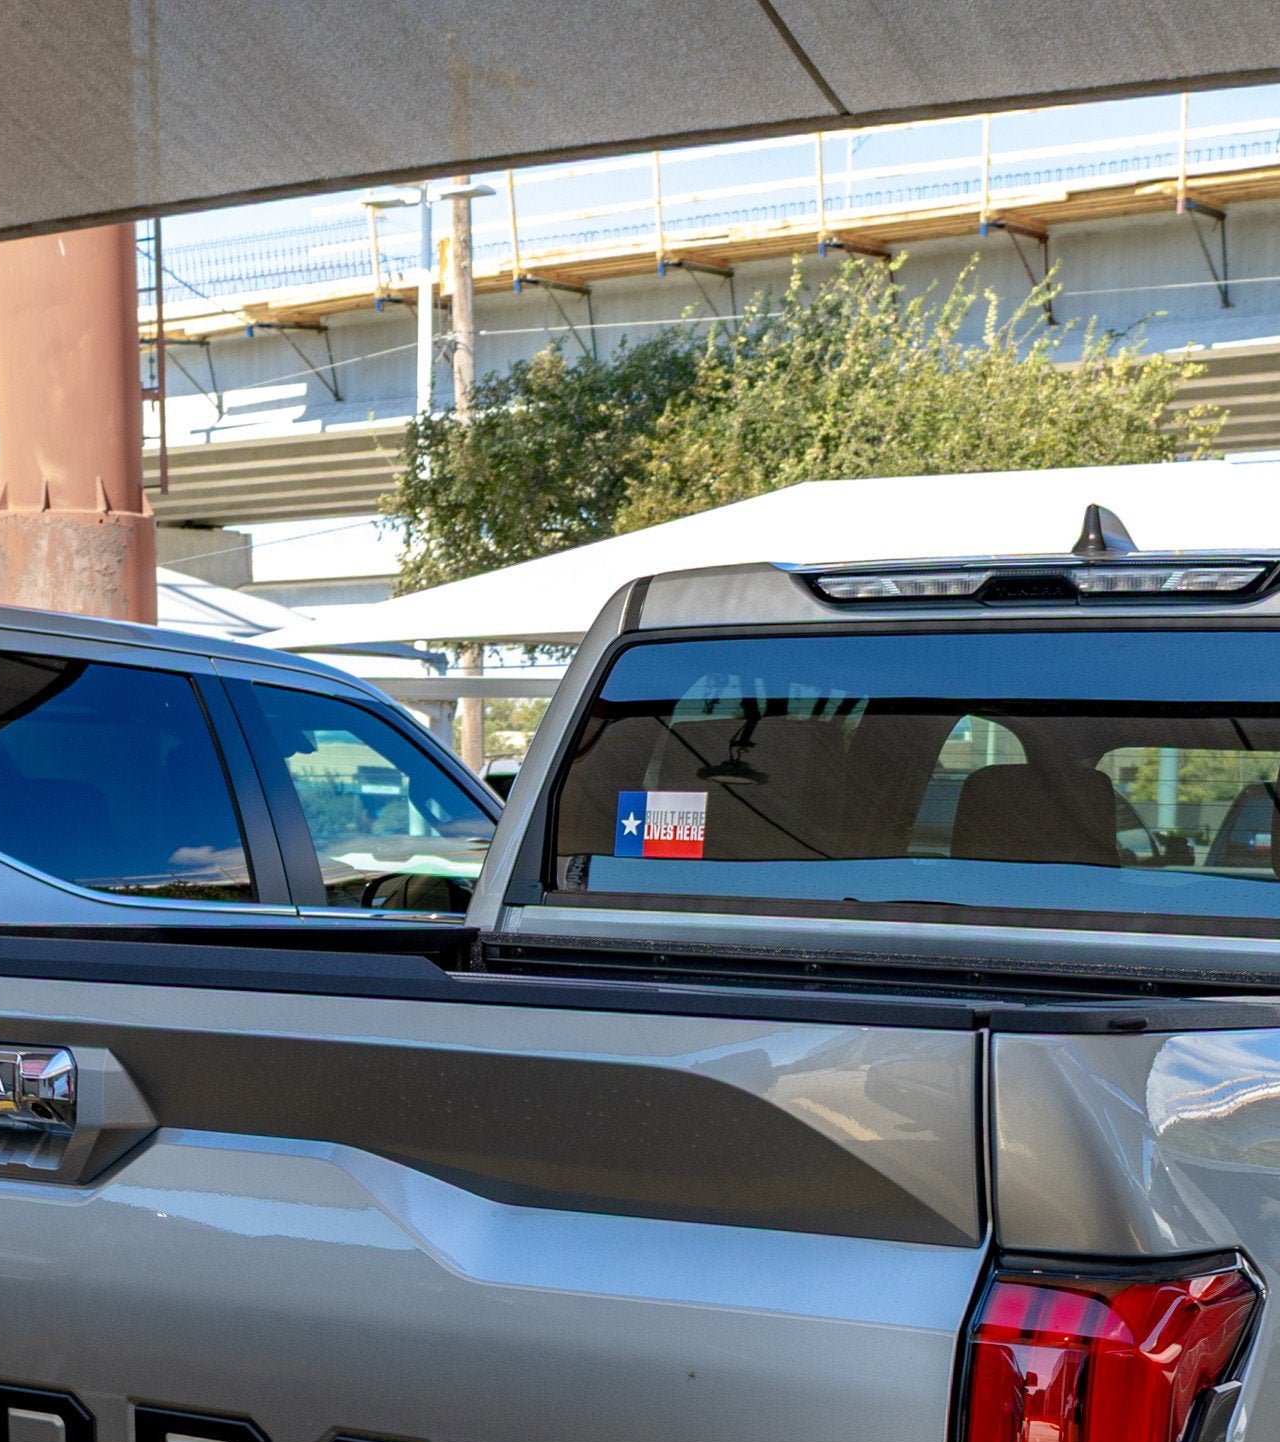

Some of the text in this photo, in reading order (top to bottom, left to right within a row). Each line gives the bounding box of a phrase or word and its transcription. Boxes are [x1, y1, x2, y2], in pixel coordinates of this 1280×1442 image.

[645, 811, 706, 826] BUILT HERE
[644, 825, 705, 840] LIVES HERE
